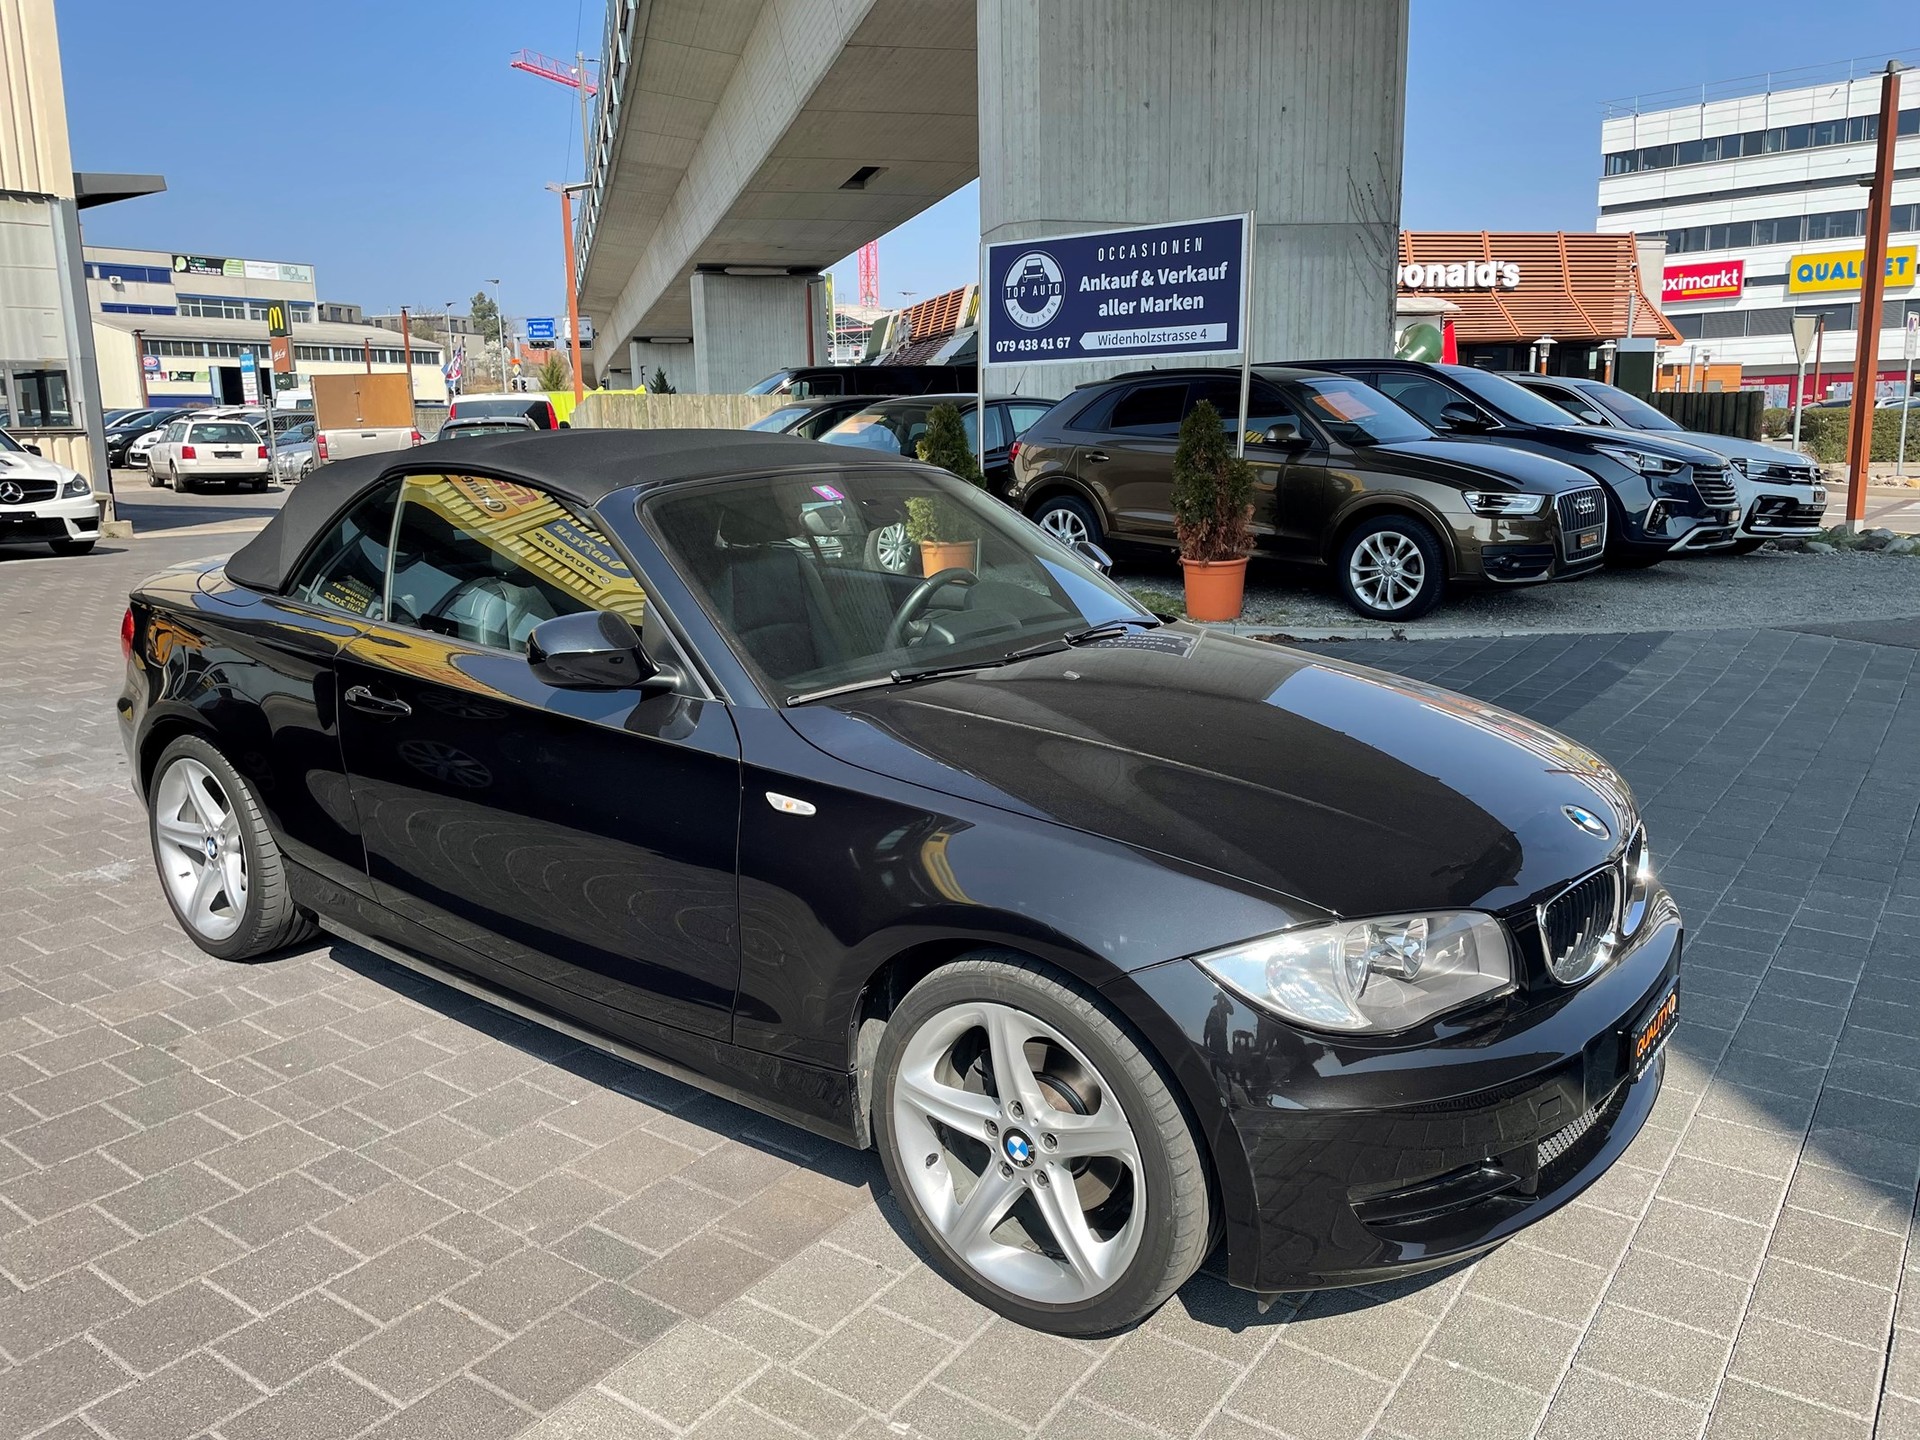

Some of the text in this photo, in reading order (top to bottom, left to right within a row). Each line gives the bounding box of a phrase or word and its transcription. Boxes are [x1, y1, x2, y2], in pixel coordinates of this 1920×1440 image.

[1098, 237, 1203, 262] OCCASIONEN
[1079, 262, 1229, 292] Ankauf & Verkauf
[1397, 261, 1520, 288] onald's
[1797, 256, 1909, 283] QUALIET
[1006, 283, 1060, 298] TOP AUTO
[1011, 301, 1057, 323] DIETLIKON
[1098, 294, 1204, 317] aller Marken
[996, 337, 1071, 352] 079 438 41 67
[1098, 328, 1207, 346] Widenholzstrasse 4
